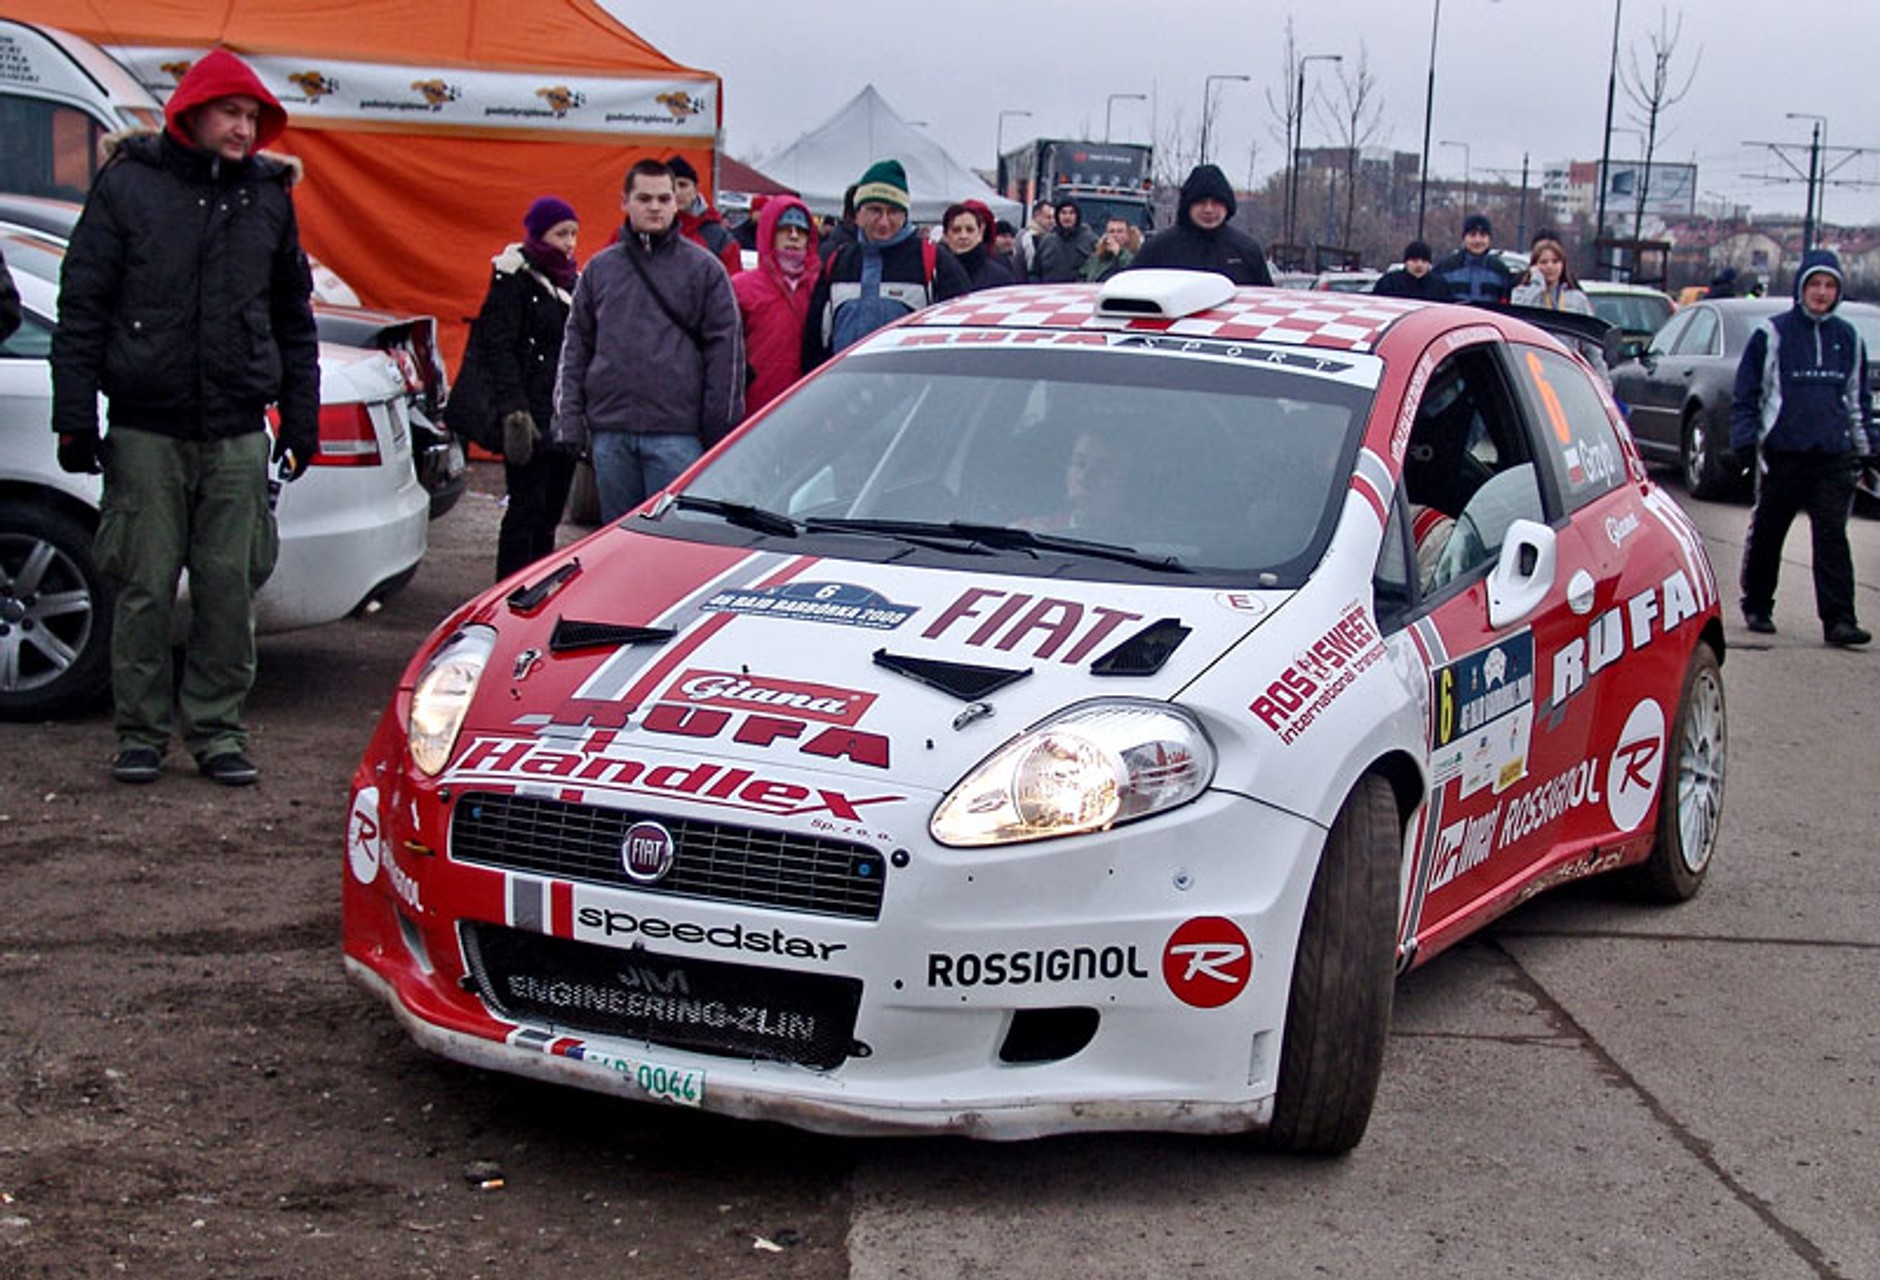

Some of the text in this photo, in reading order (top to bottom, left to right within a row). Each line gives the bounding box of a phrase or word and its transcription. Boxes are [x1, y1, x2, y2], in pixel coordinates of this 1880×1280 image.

[899, 332, 1333, 372] RUFA SPORT
[1526, 352, 1571, 444] 6
[815, 585, 841, 599] 6
[920, 587, 1145, 664] FIAT
[1551, 569, 1699, 708] RUFA
[679, 672, 853, 716] Giana
[1440, 668, 1454, 745] 6
[550, 700, 891, 769] RUFA
[1615, 737, 1661, 795] R
[629, 840, 668, 869] FIAT
[577, 906, 847, 961] speedstar
[927, 946, 1149, 988] ROSSIGNOL
[1169, 943, 1246, 984] R
